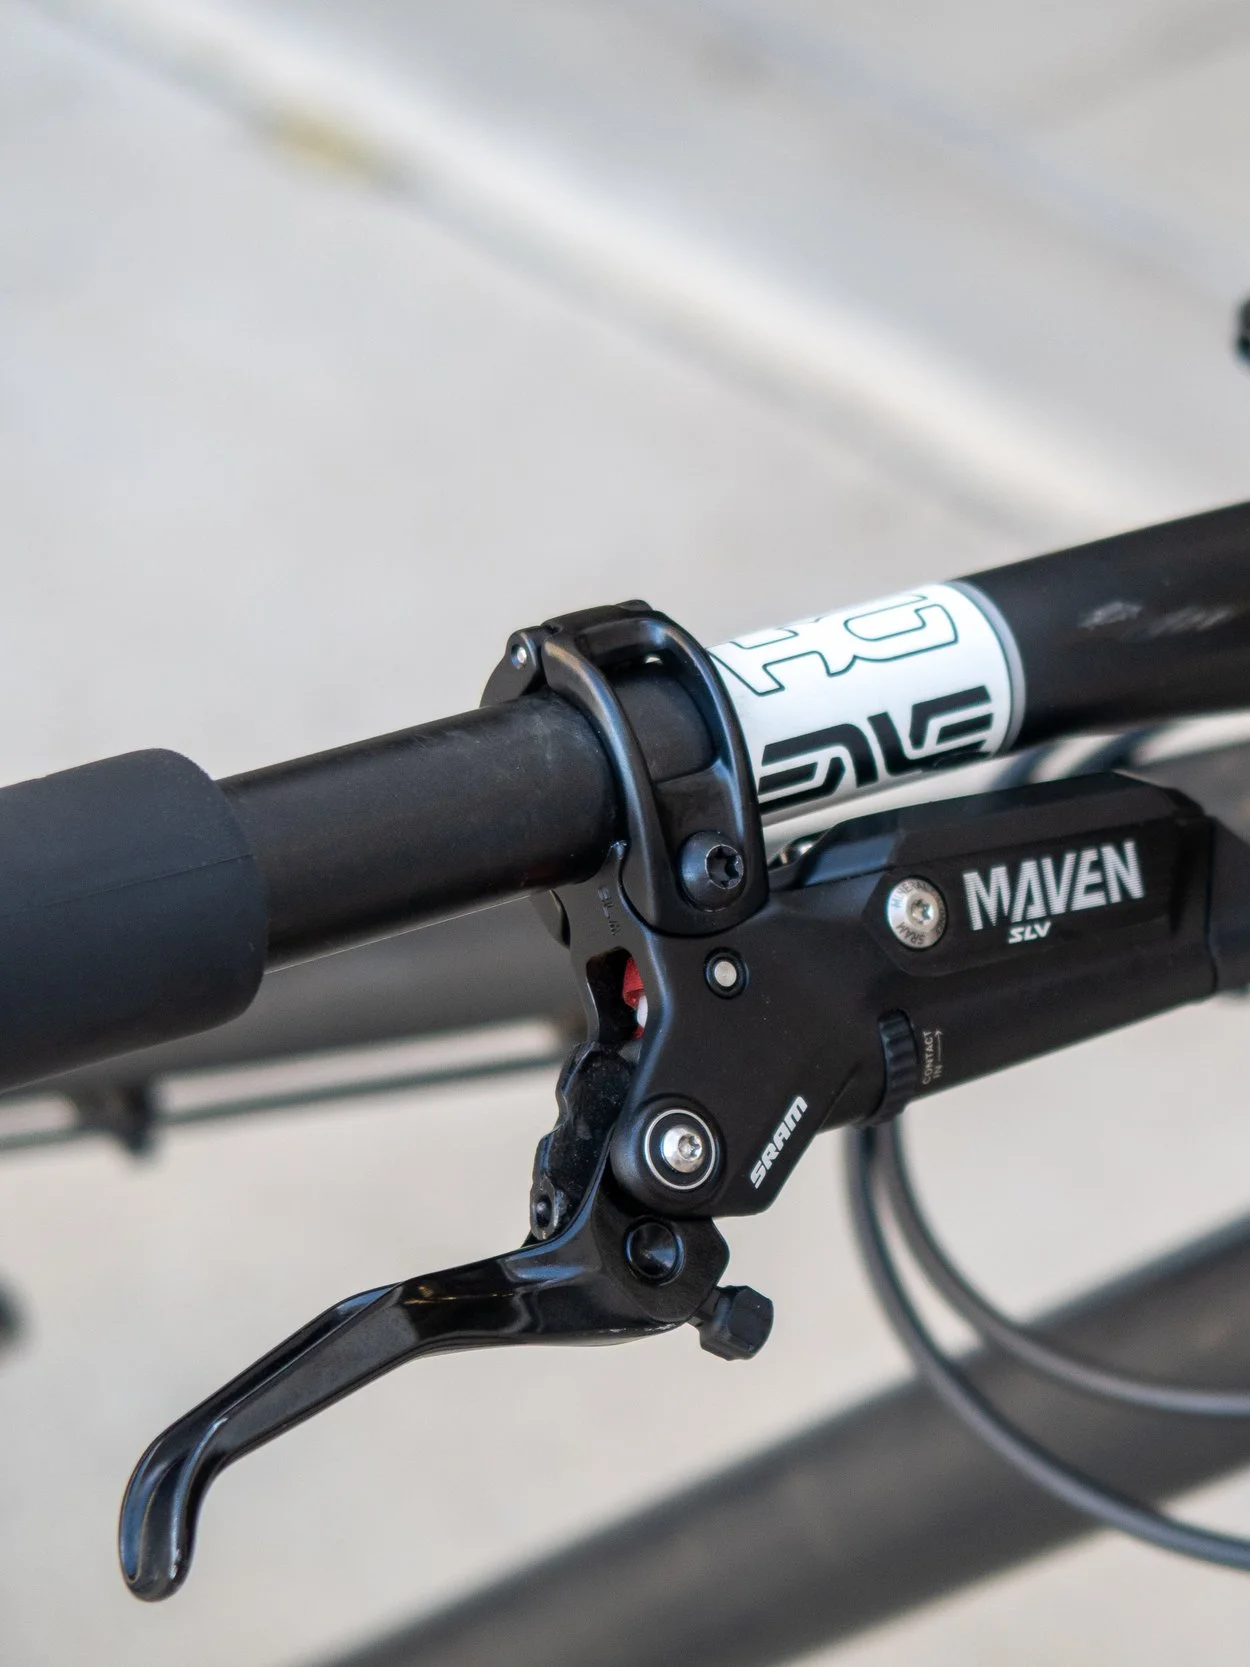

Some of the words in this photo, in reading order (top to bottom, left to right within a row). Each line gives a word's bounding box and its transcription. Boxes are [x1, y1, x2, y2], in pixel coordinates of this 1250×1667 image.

[962, 838, 1145, 931] MAVEN
[895, 921, 927, 945] SRAM
[1007, 920, 1052, 945] SLV
[922, 1030, 935, 1086] CONTACT
[749, 1095, 808, 1190] SRAM
